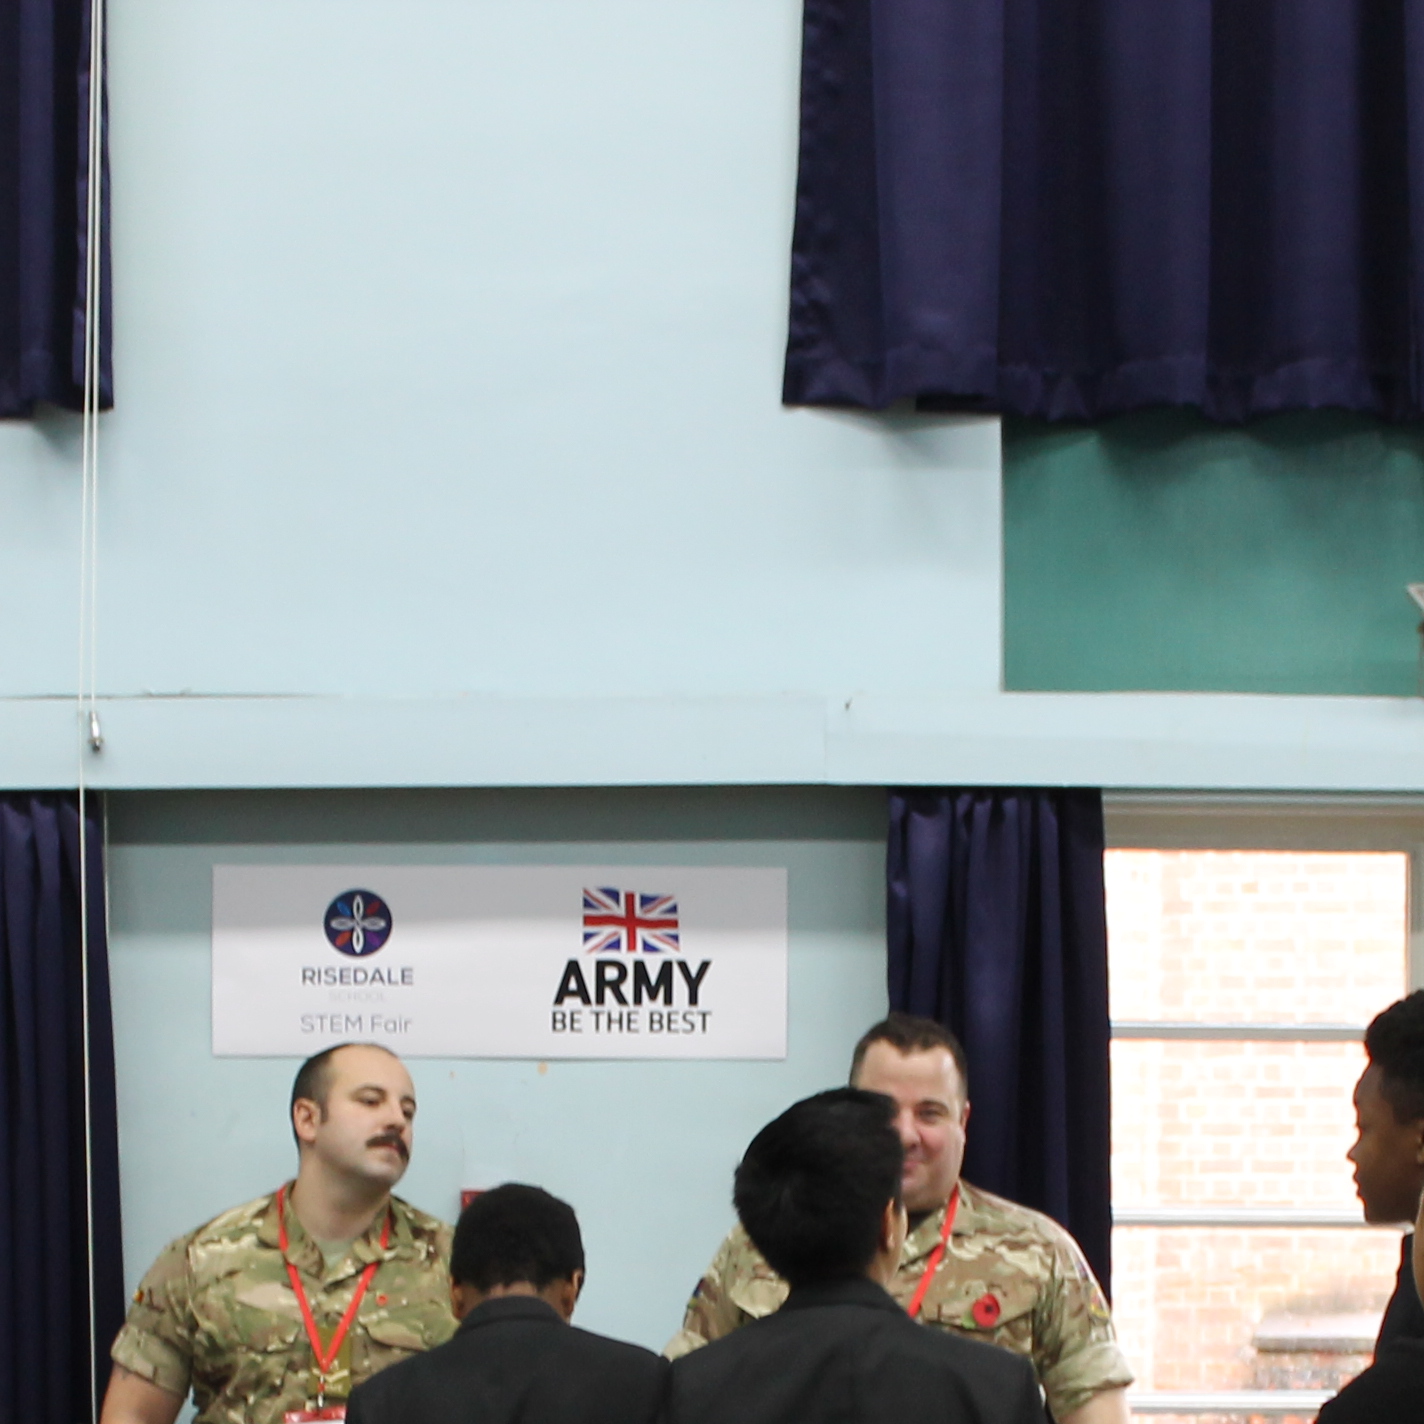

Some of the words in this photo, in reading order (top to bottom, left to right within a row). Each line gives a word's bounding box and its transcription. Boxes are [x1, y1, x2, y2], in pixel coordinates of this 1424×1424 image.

[301, 967, 414, 986] RISEDALE
[553, 959, 712, 1007] ARMY
[300, 1014, 364, 1034] STEM
[370, 1013, 413, 1034] Fair
[551, 1011, 581, 1033] BE
[591, 1011, 639, 1033] THE
[648, 1011, 712, 1034] BEST
